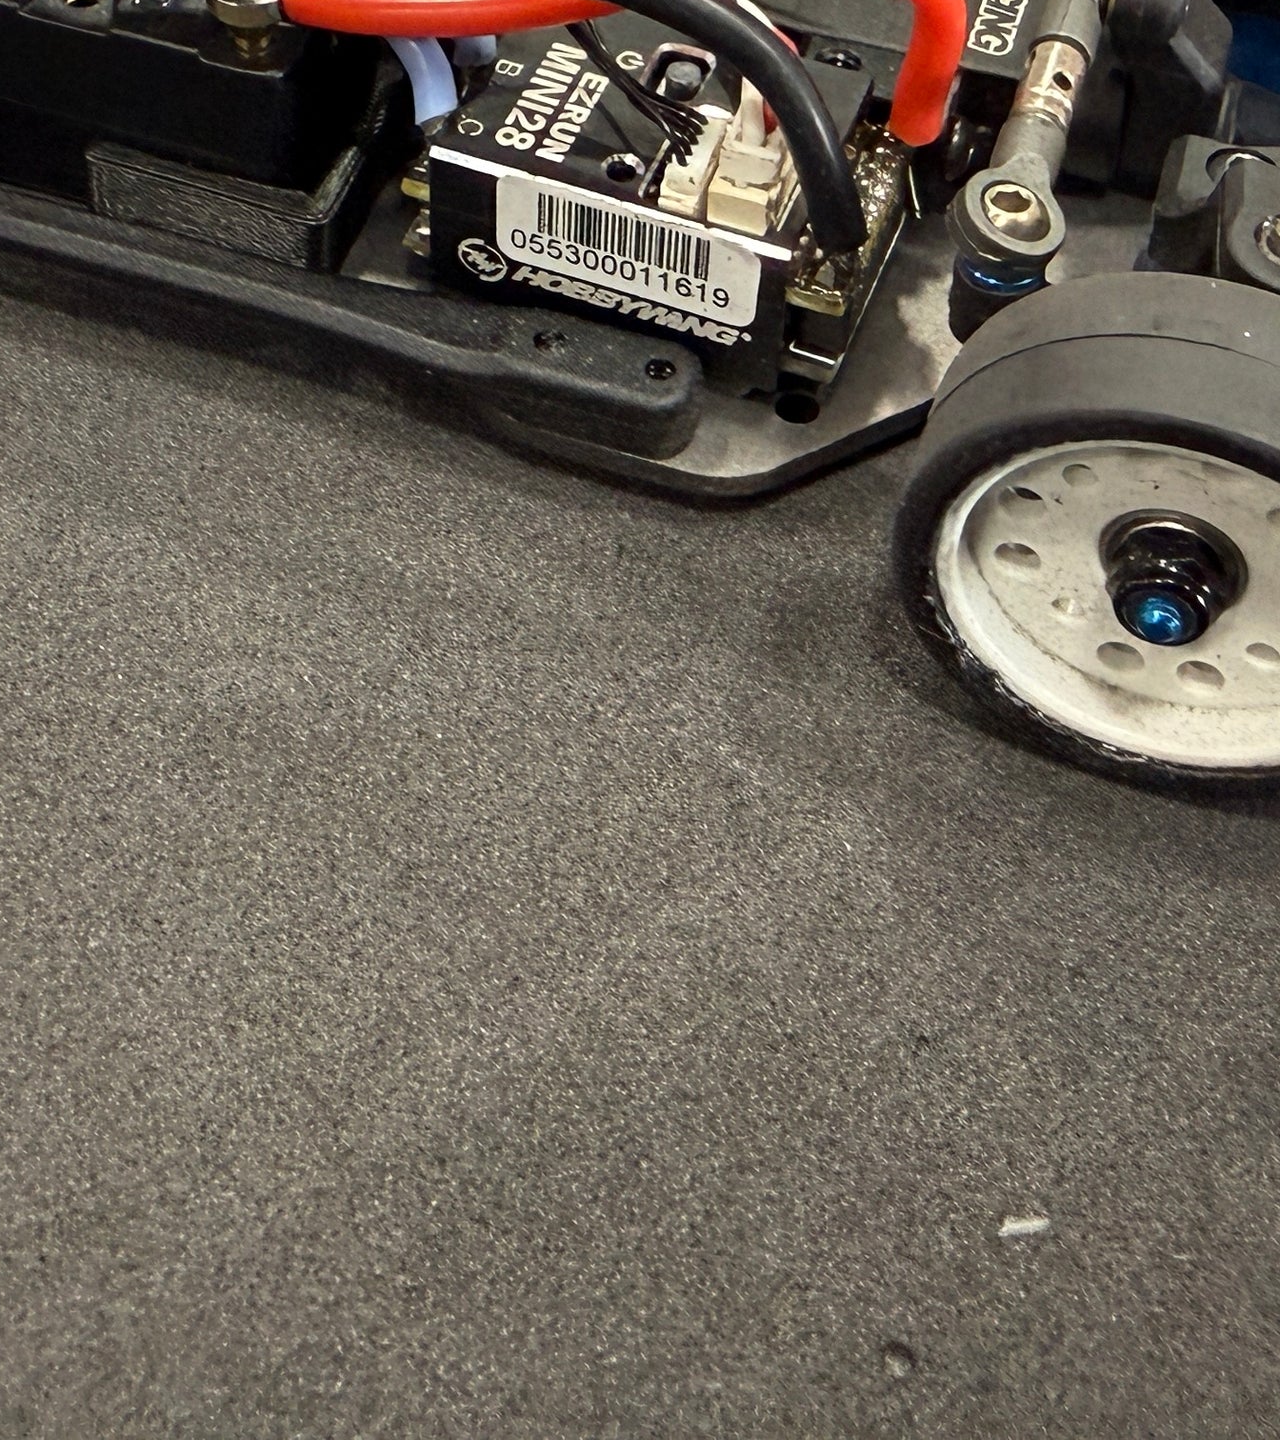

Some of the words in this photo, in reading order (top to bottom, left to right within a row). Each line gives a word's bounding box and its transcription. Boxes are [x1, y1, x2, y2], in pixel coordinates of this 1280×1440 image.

[494, 42, 589, 151] MINI28
[535, 72, 610, 162] EZRUN
[510, 228, 730, 308] 055300011619
